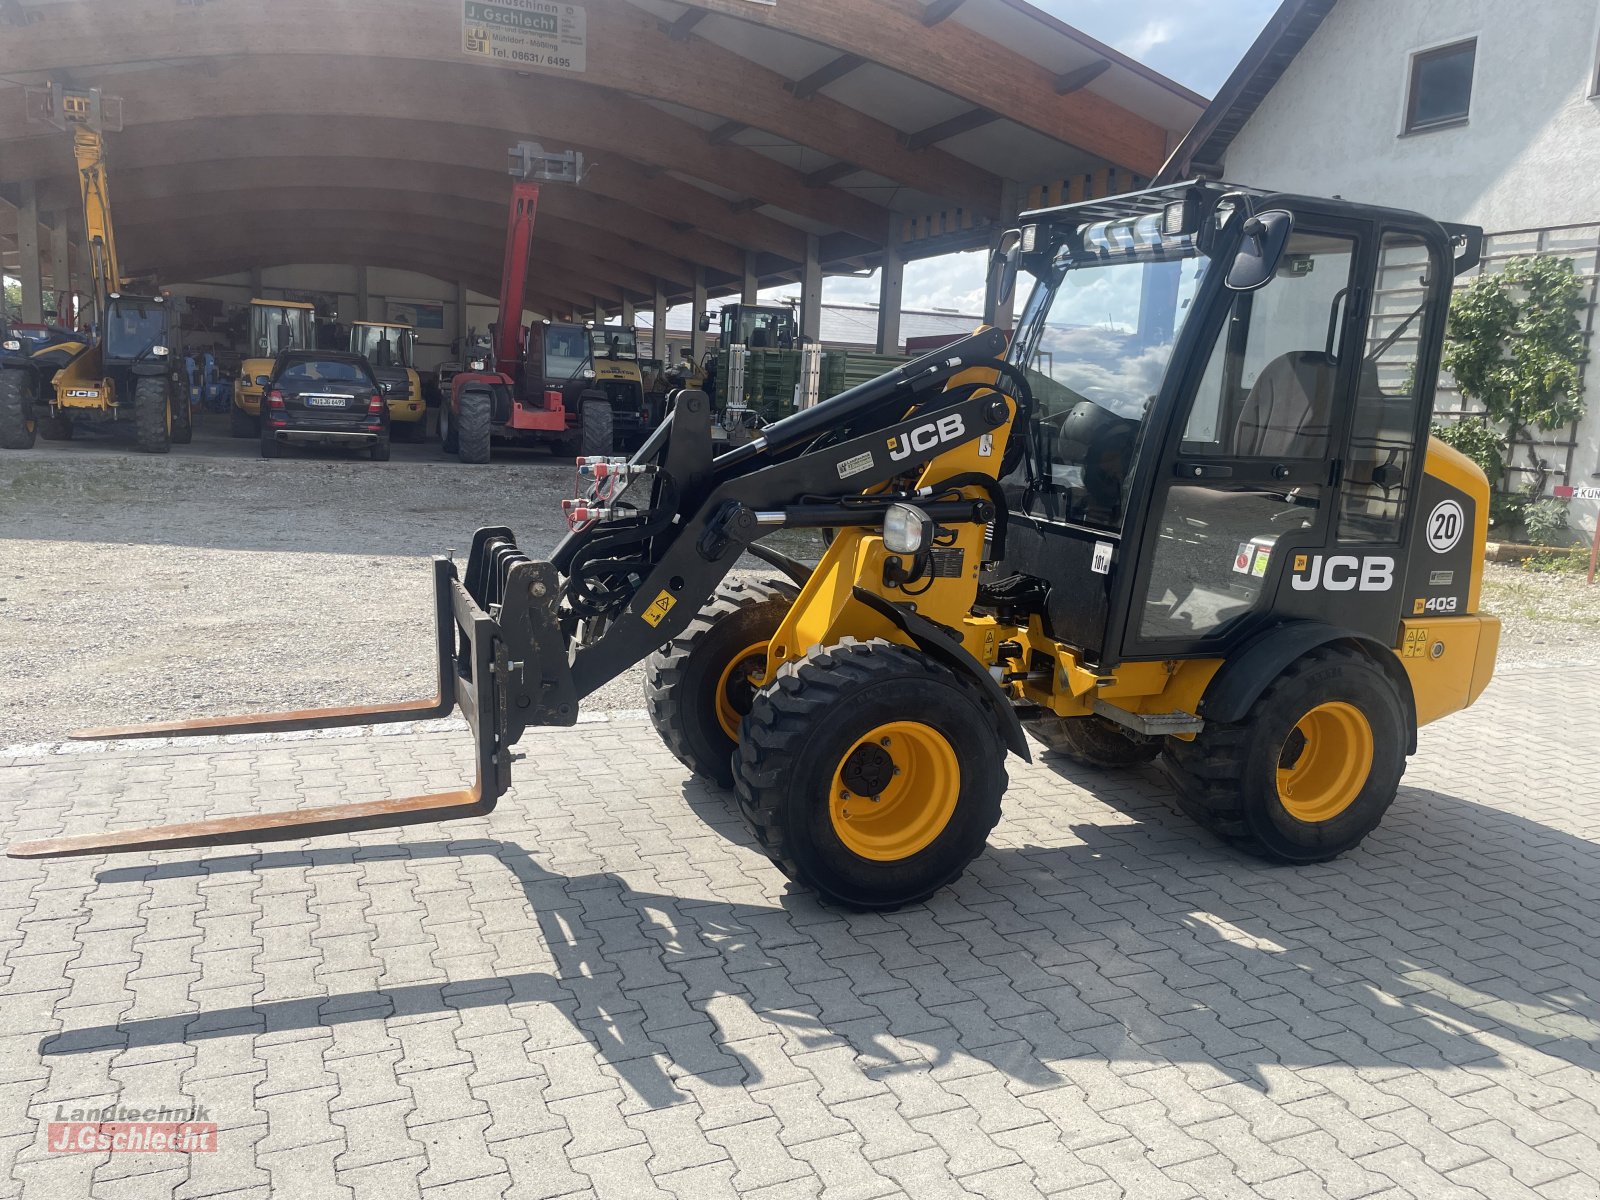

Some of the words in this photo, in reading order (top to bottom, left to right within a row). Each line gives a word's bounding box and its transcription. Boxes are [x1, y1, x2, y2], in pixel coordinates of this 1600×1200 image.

[468, 5, 480, 19] J.
[483, 8, 555, 30] Gschlecht
[492, 47, 510, 59] Tel.
[547, 56, 570, 68] 6495
[66, 390, 99, 398] JCB
[888, 413, 966, 462] JCB
[1432, 513, 1458, 540] 20
[1291, 555, 1395, 592] JCB
[1425, 596, 1458, 611] 403
